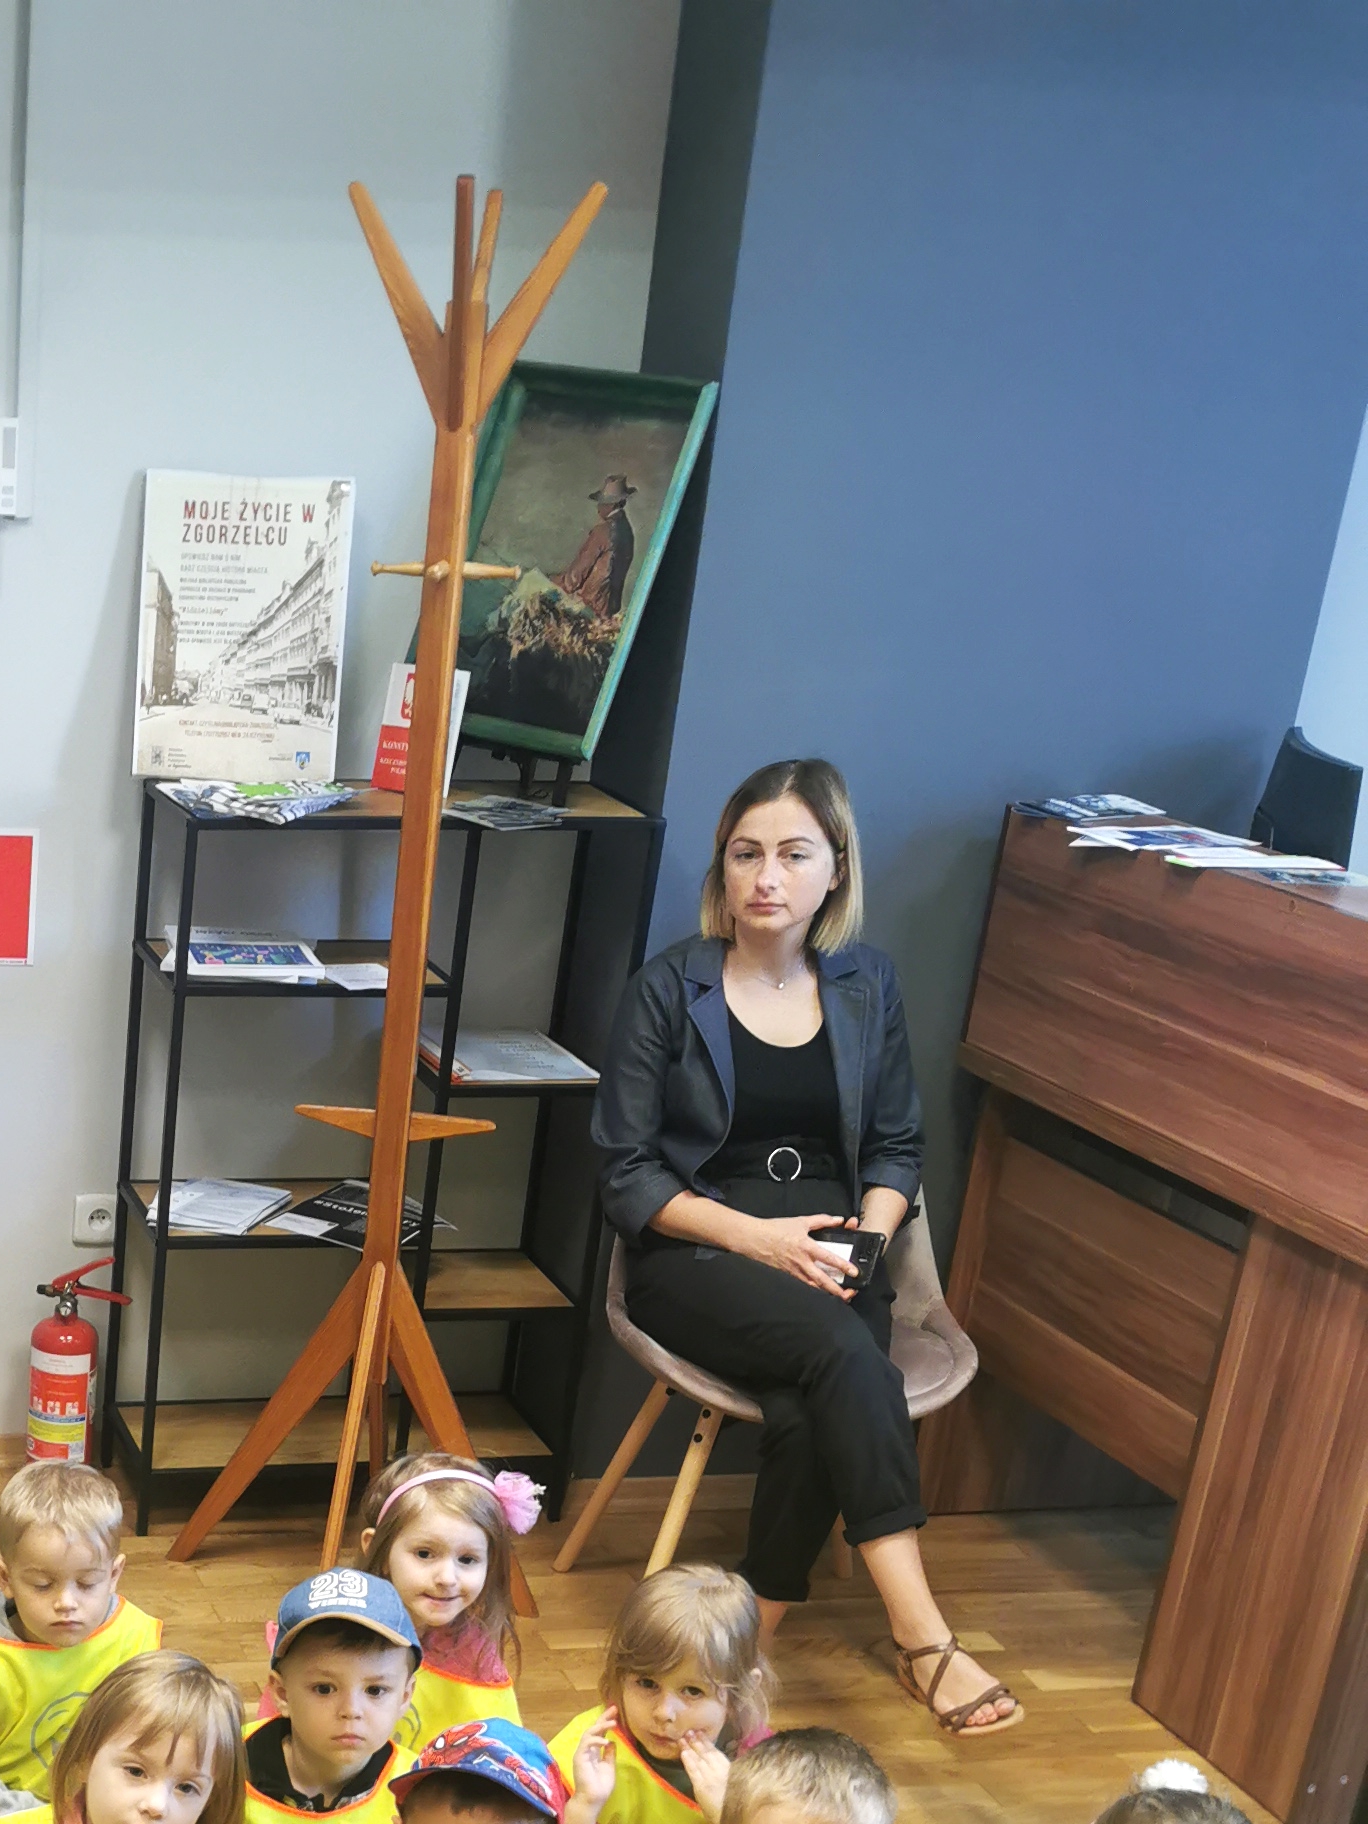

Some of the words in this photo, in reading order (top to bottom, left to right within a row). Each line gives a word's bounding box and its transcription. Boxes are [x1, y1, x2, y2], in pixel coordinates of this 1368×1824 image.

[183, 500, 230, 520] MOJE
[239, 498, 292, 522] ŻYCIE
[302, 503, 315, 523] W
[182, 523, 288, 546] ZGORZELCU
[308, 1569, 369, 1602] 23
